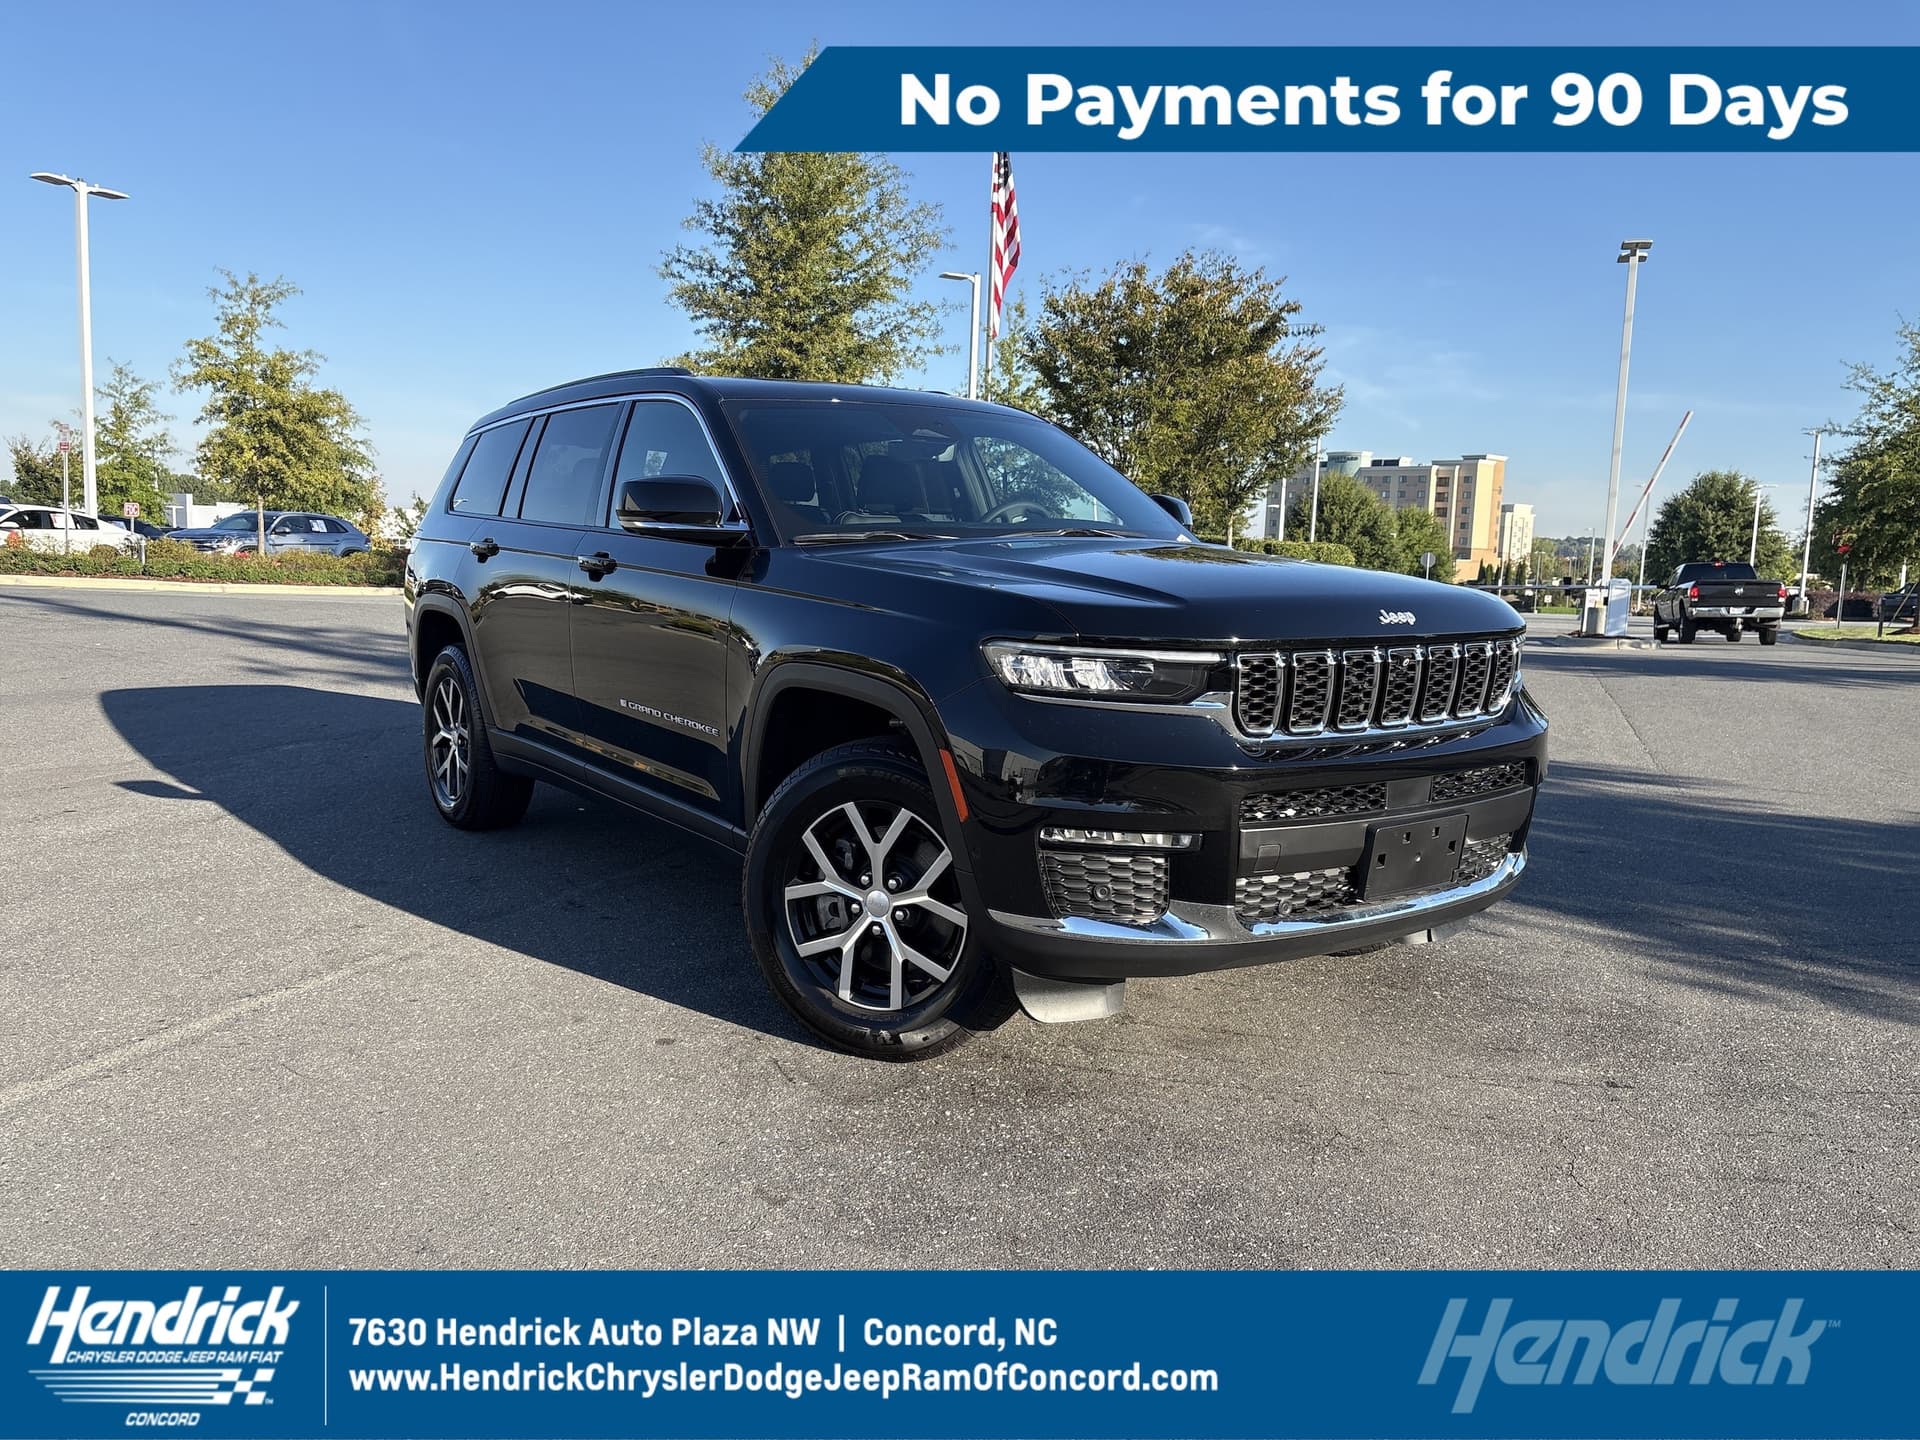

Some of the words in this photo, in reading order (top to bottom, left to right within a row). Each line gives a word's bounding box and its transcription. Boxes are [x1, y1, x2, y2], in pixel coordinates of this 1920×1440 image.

[1378, 609, 1416, 625] Jeep
[628, 701, 662, 718] GRAND
[663, 712, 720, 737] CHEROKEE
